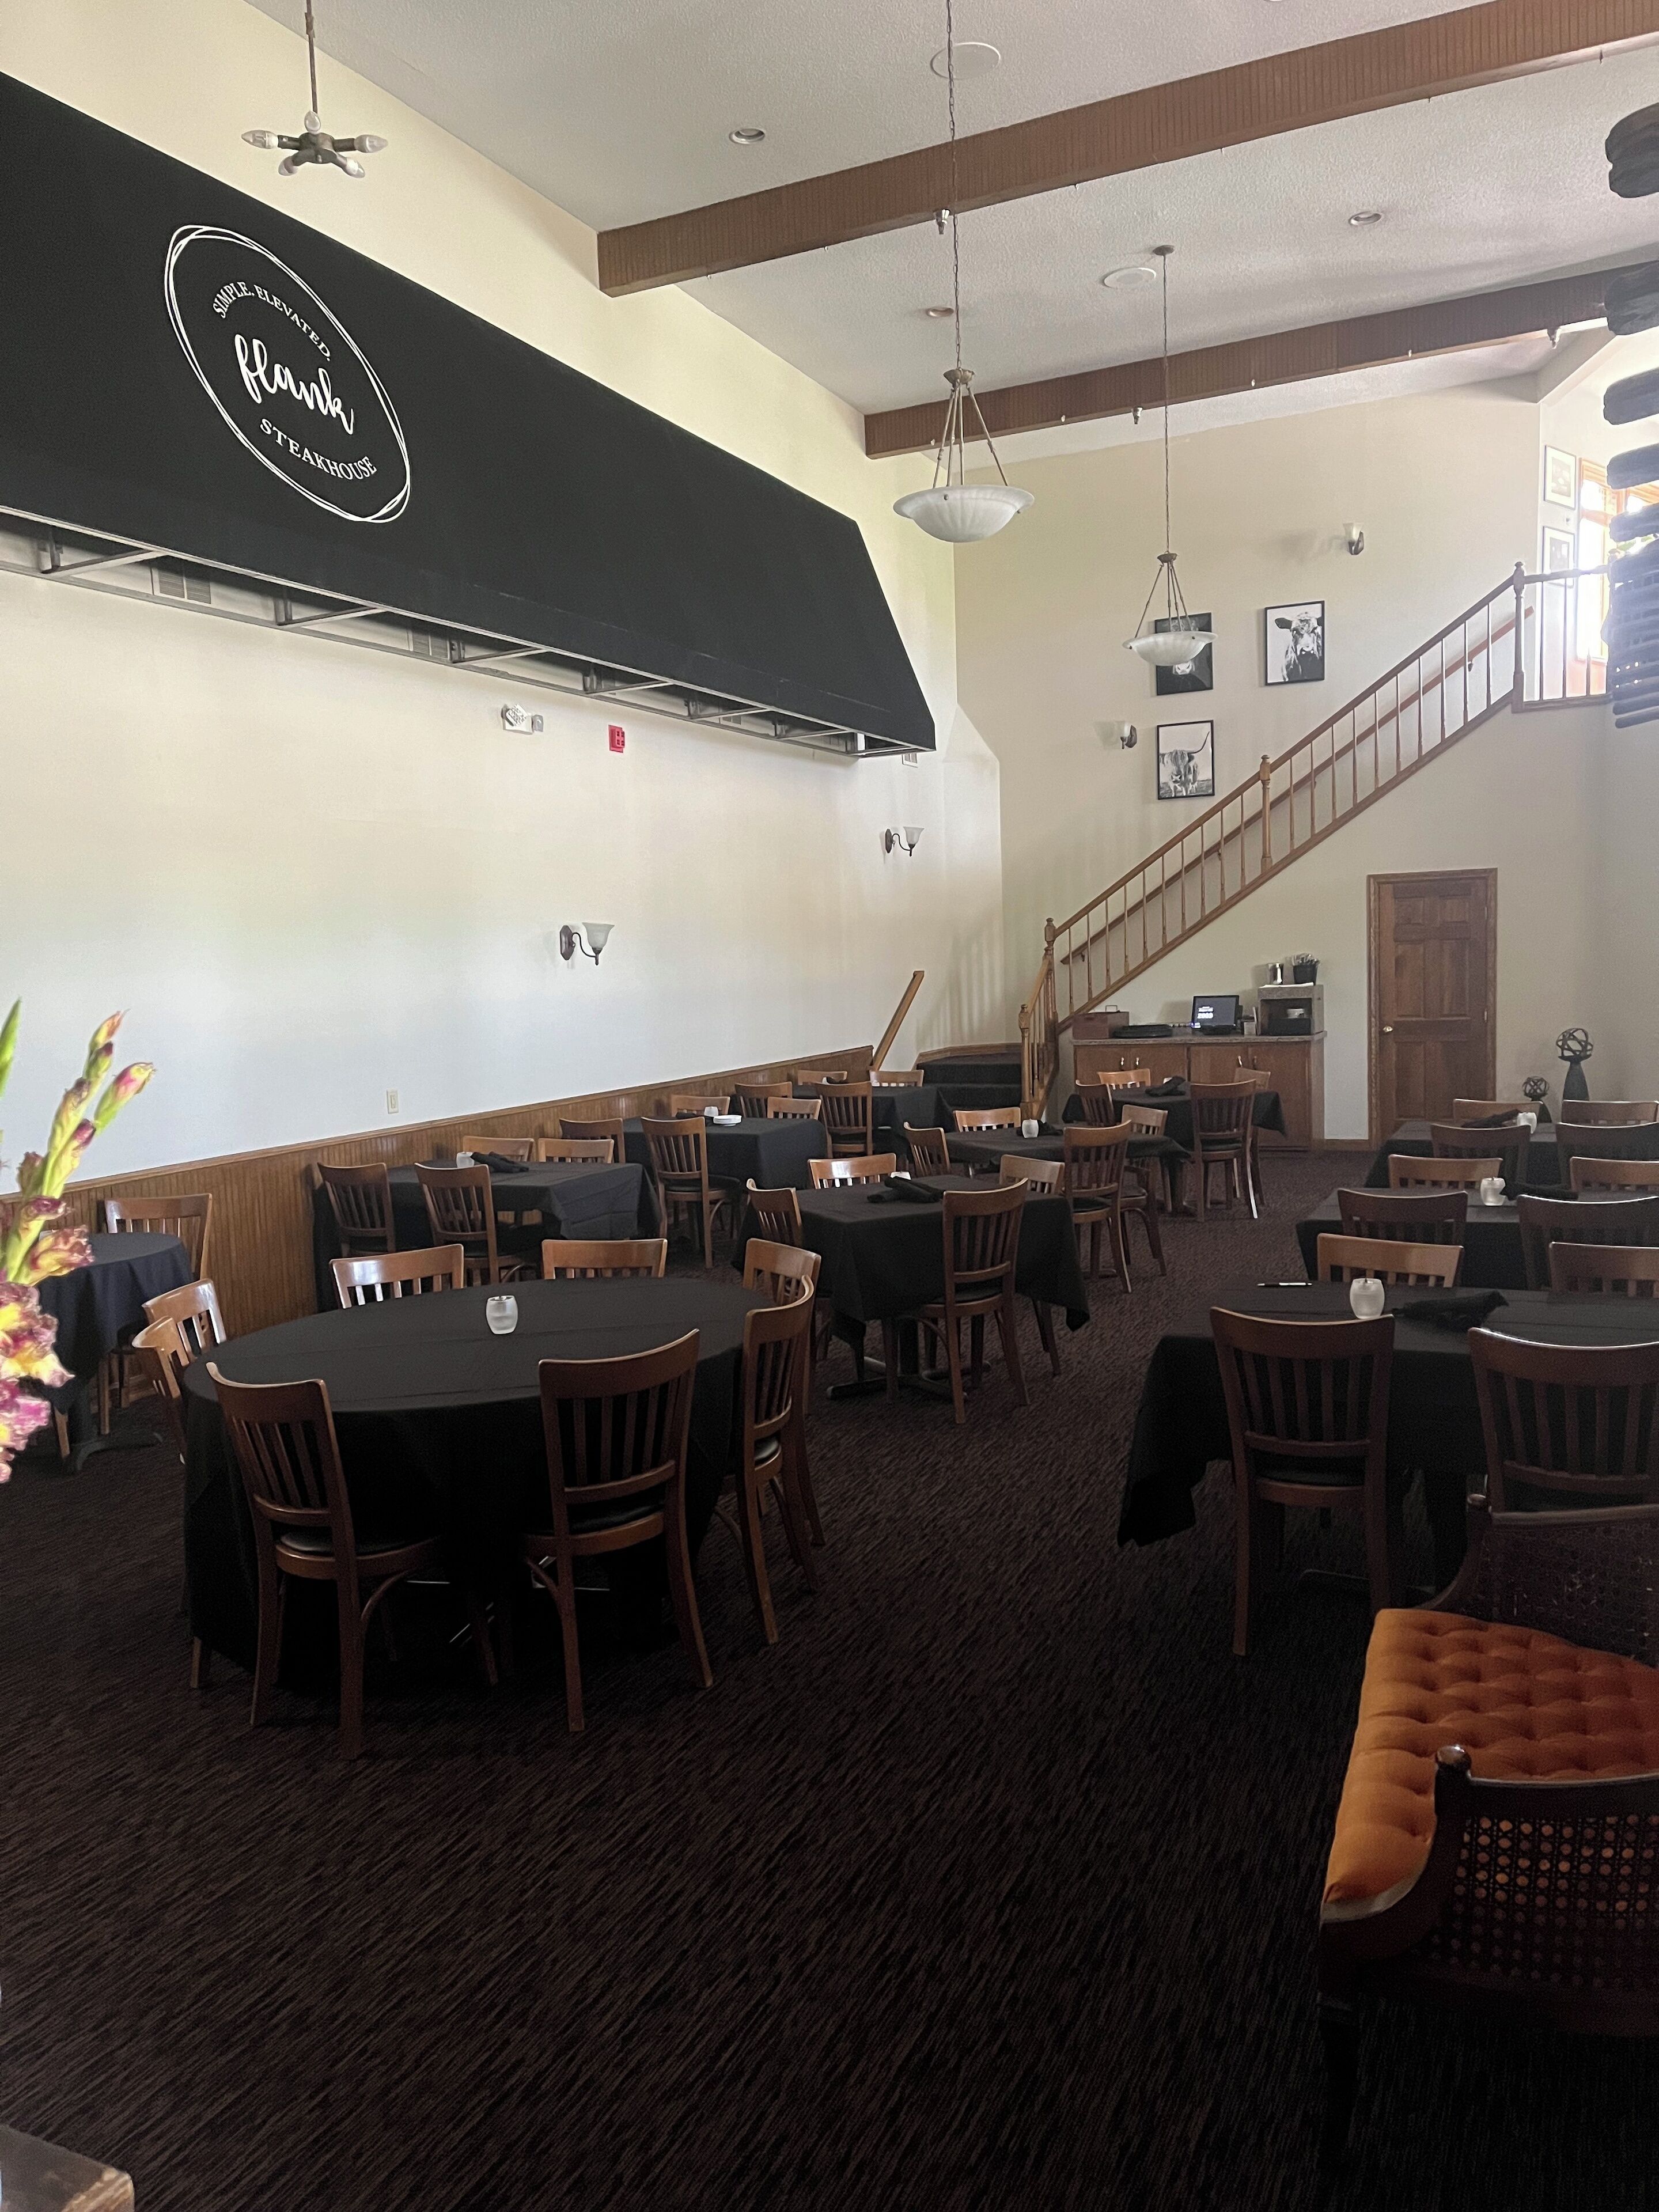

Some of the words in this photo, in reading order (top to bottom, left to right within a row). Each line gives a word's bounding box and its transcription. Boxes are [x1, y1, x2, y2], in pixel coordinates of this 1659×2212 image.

[213, 282, 255, 319] SIMPLE.
[253, 284, 330, 361] ELEVATED.
[234, 334, 354, 435] flank
[260, 418, 377, 480] STEAKHOUSE
